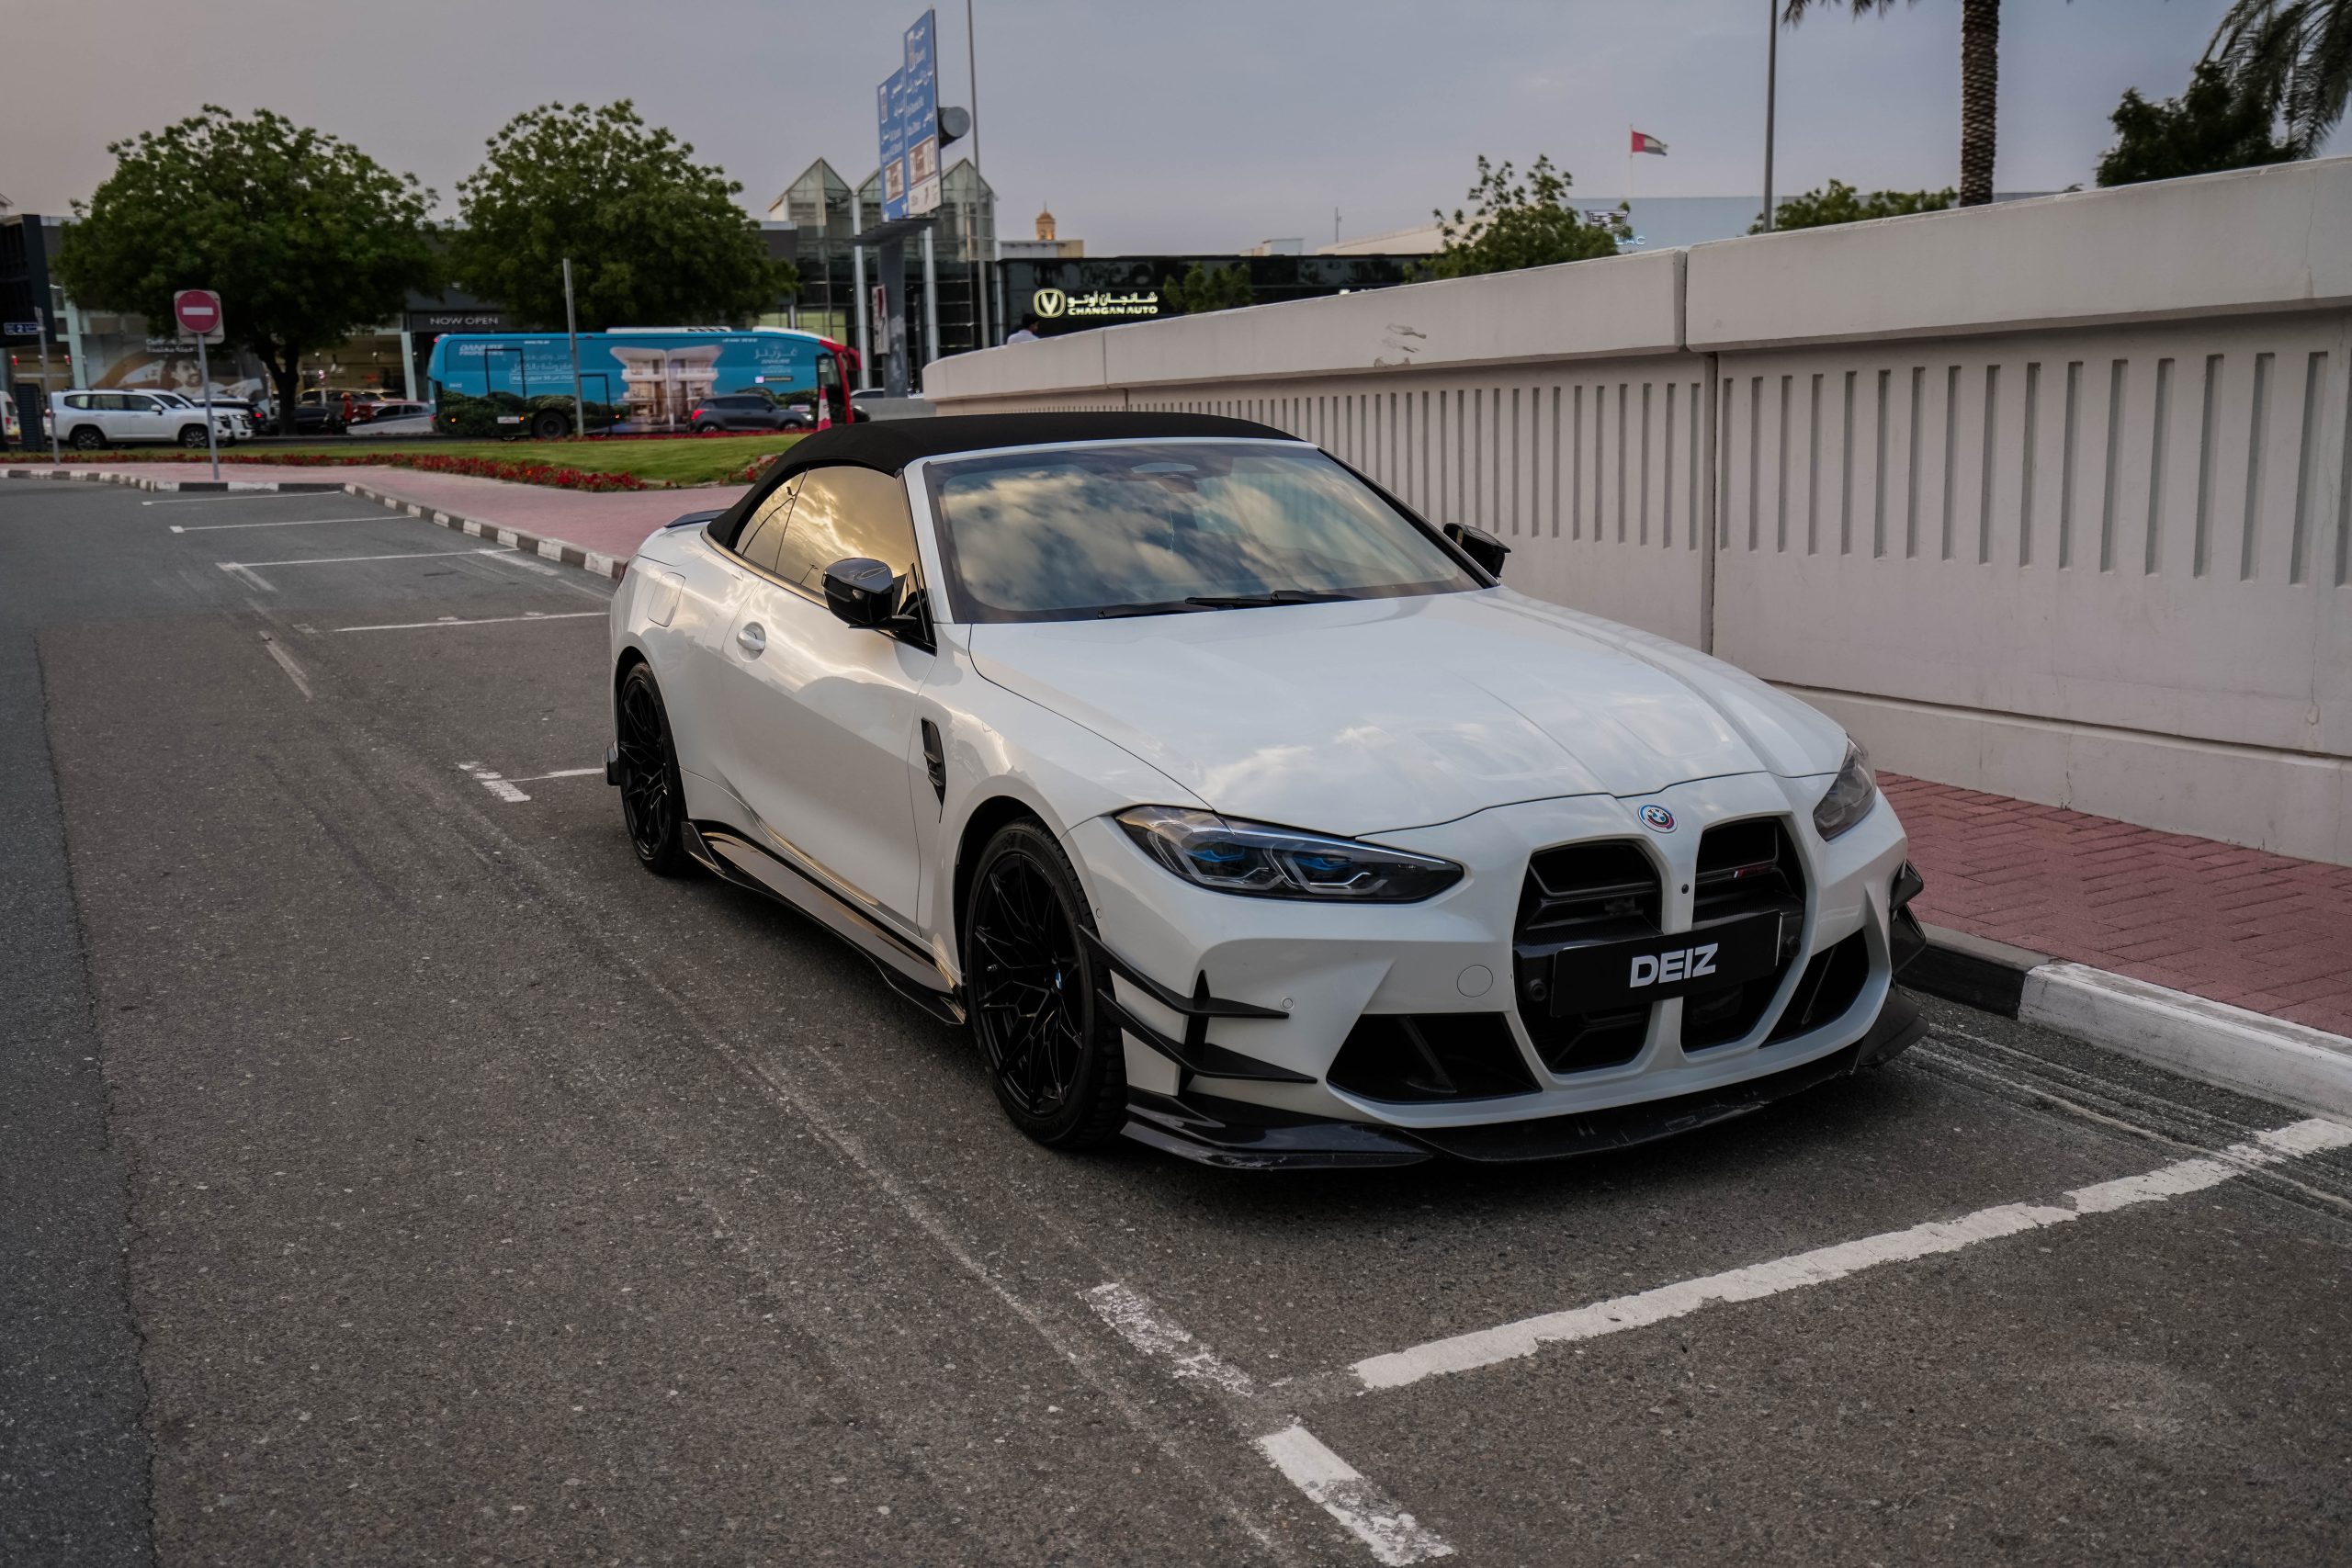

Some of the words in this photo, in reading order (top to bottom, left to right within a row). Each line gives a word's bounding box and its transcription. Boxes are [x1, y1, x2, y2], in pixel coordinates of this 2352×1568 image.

[1068, 306, 1127, 315] CHANGAN
[1126, 306, 1158, 314] AUTO
[429, 317, 463, 325] NOW
[464, 317, 499, 325] OPEN
[1629, 942, 1719, 988] DEIZ
